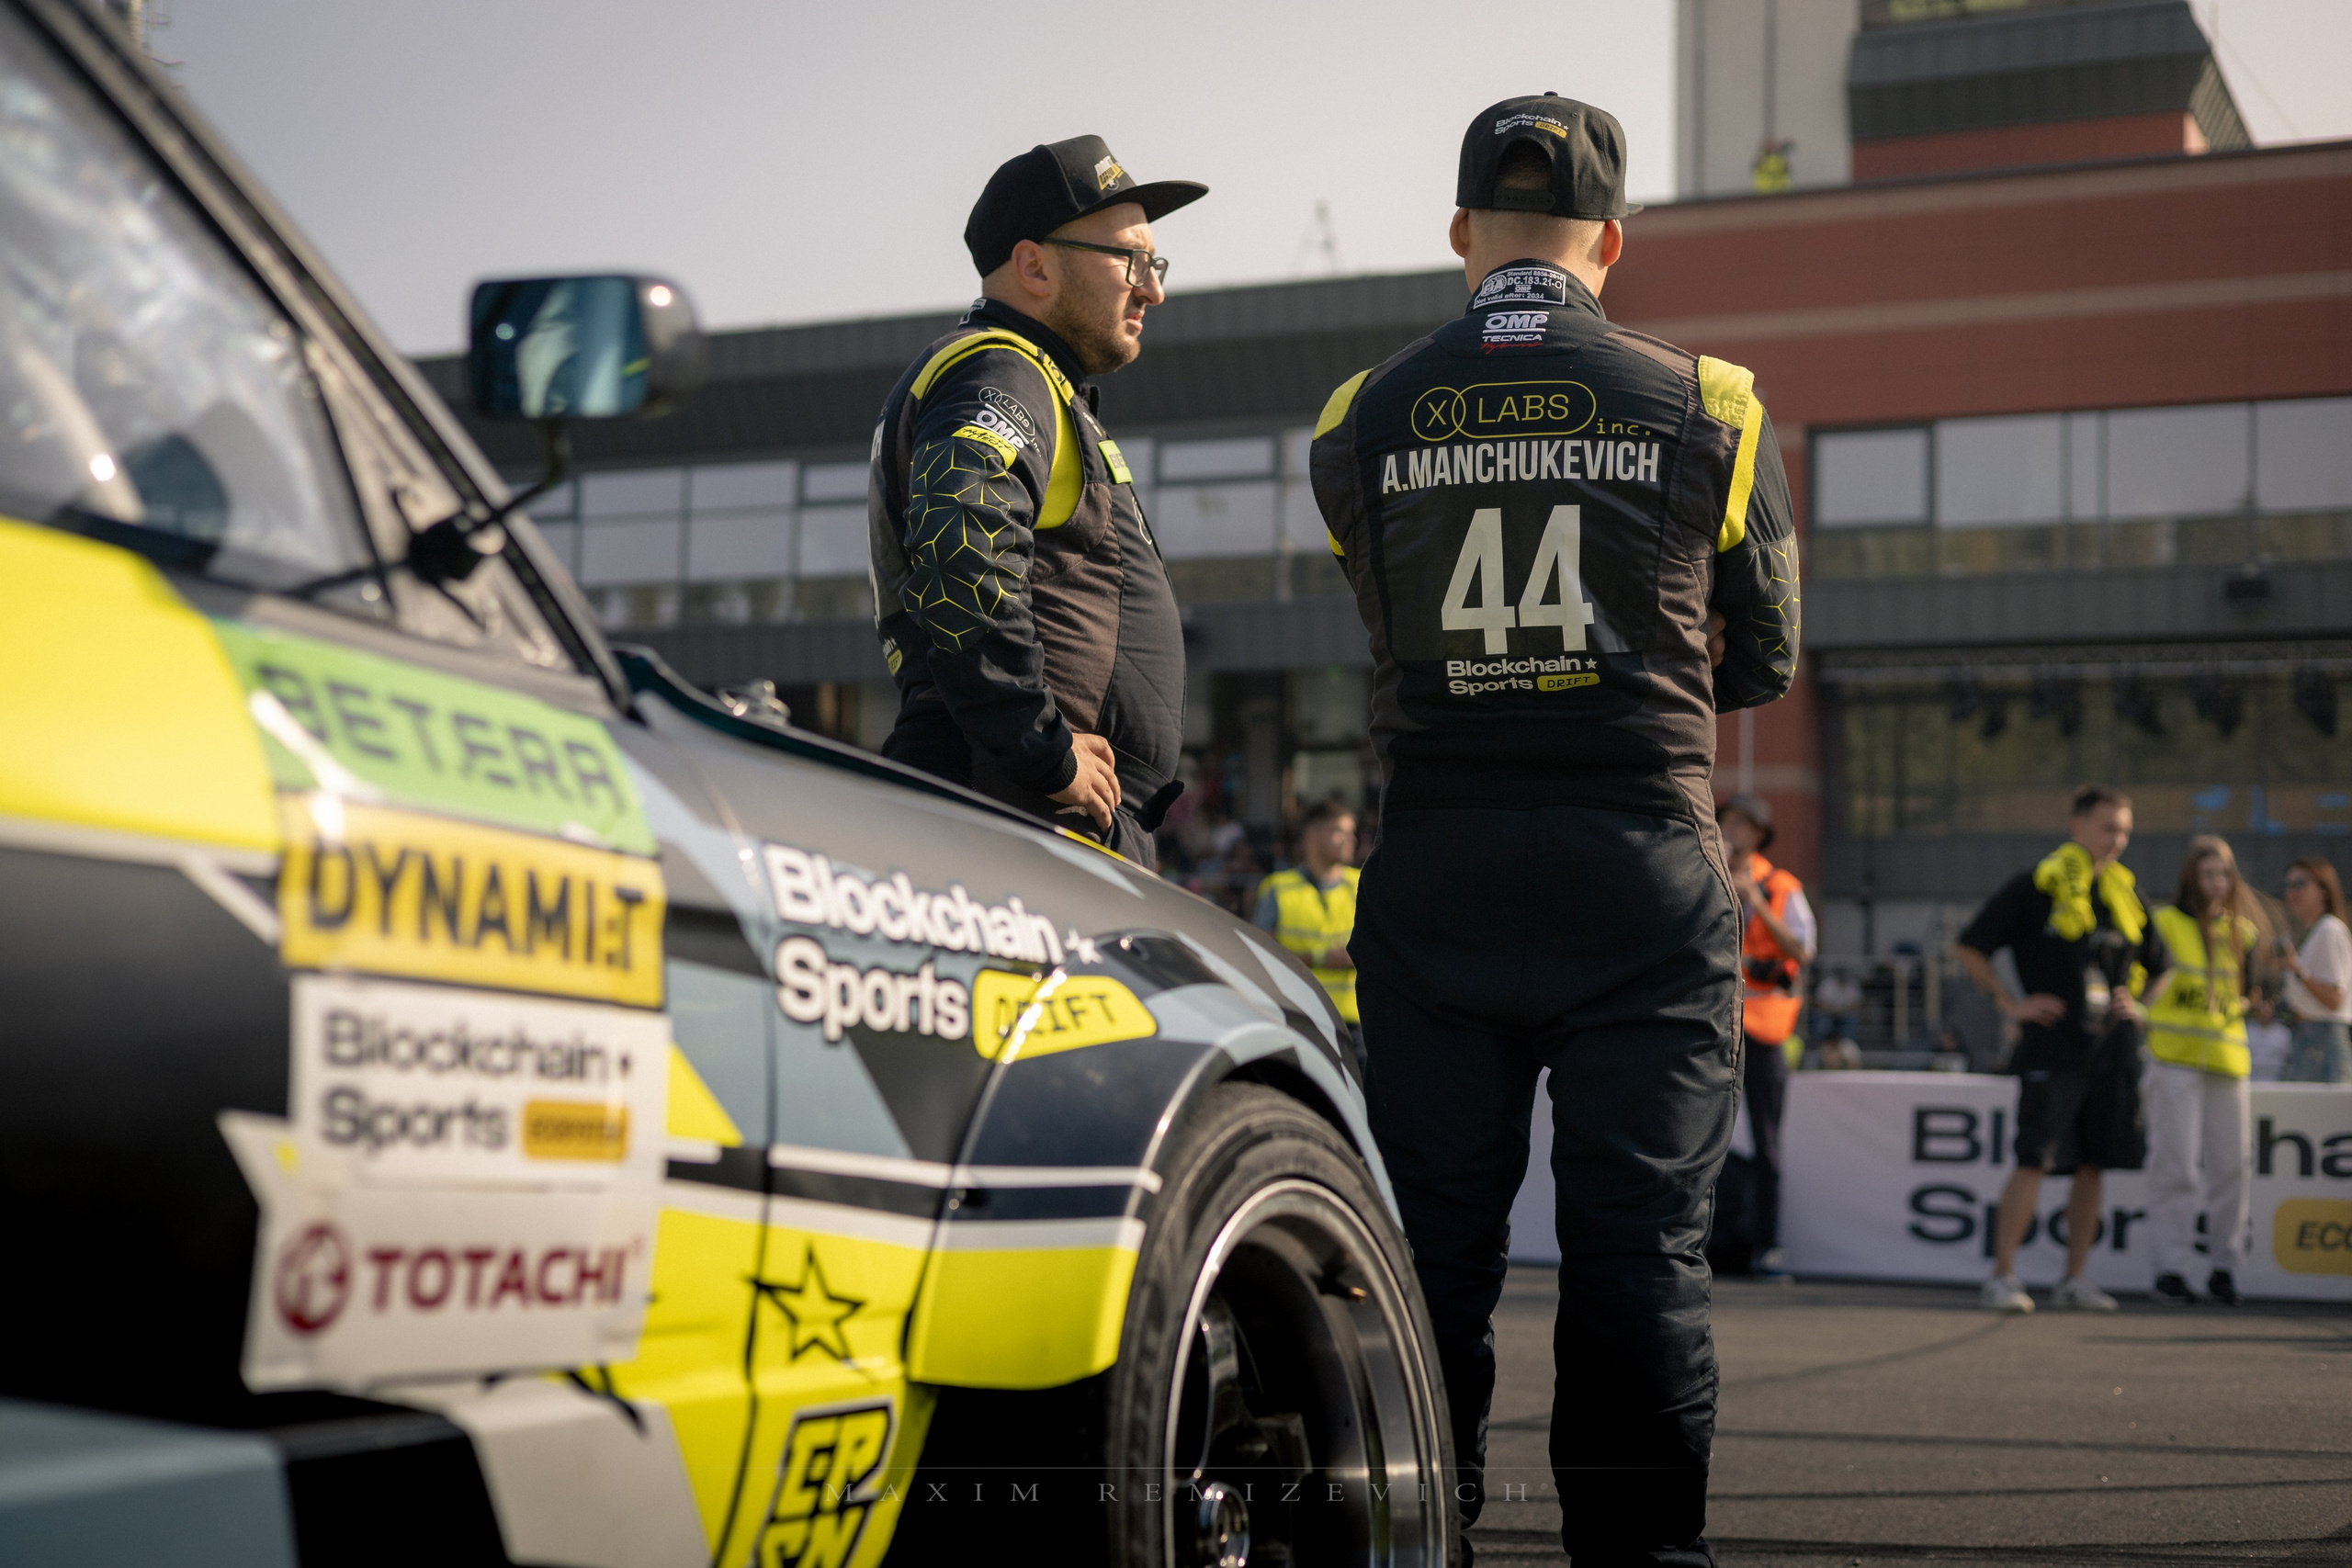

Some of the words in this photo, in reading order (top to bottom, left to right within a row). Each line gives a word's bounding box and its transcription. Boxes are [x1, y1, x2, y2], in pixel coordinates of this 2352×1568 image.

[1494, 119, 1533, 135] Sports
[1540, 122, 1562, 133] DRIFT
[1496, 114, 1562, 128] Blockchain
[1476, 297, 1487, 305] Not
[1487, 293, 1503, 301] valid
[1485, 314, 1548, 329] OMP
[984, 389, 997, 401] X
[1002, 399, 1030, 428] LABS
[1426, 400, 1447, 427] X
[1477, 394, 1569, 423] LABS
[1596, 418, 1651, 436] inc.
[976, 410, 1024, 448] OMP
[1382, 439, 1660, 494] A.MANCHUKEVICH
[1442, 504, 1595, 655] 44
[1446, 656, 1582, 677] Blockchain
[1448, 676, 1534, 696] Sports
[1546, 676, 1591, 689] DRIFT
[763, 840, 1065, 964] Blockchain
[774, 934, 969, 1043] Sports
[997, 993, 1118, 1037] DRIFT
[322, 1012, 608, 1083] Blockchain
[322, 1087, 509, 1155] Sports
[365, 1246, 628, 1313] TOTACHI
